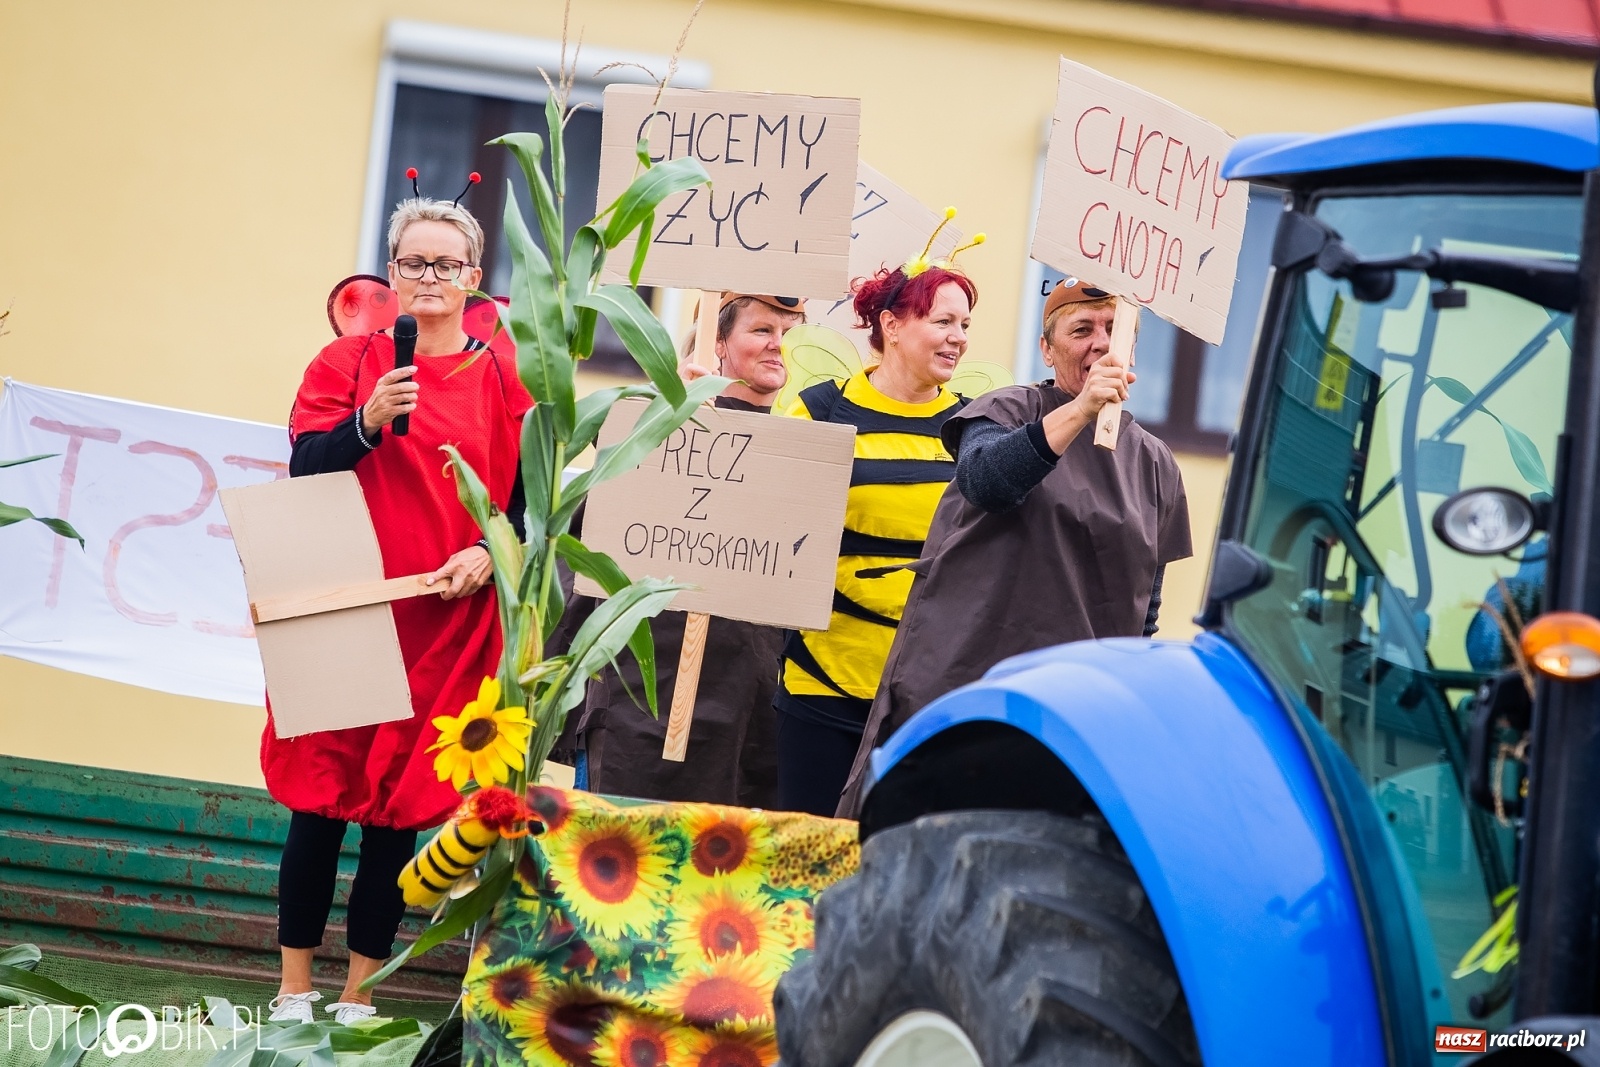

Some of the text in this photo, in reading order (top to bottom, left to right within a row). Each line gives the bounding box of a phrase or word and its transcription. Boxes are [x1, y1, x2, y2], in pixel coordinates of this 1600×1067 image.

[636, 110, 827, 170] CHCEMY
[1074, 106, 1230, 231] CHCEMY
[636, 426, 753, 483] RECZ
[683, 487, 712, 521] Z
